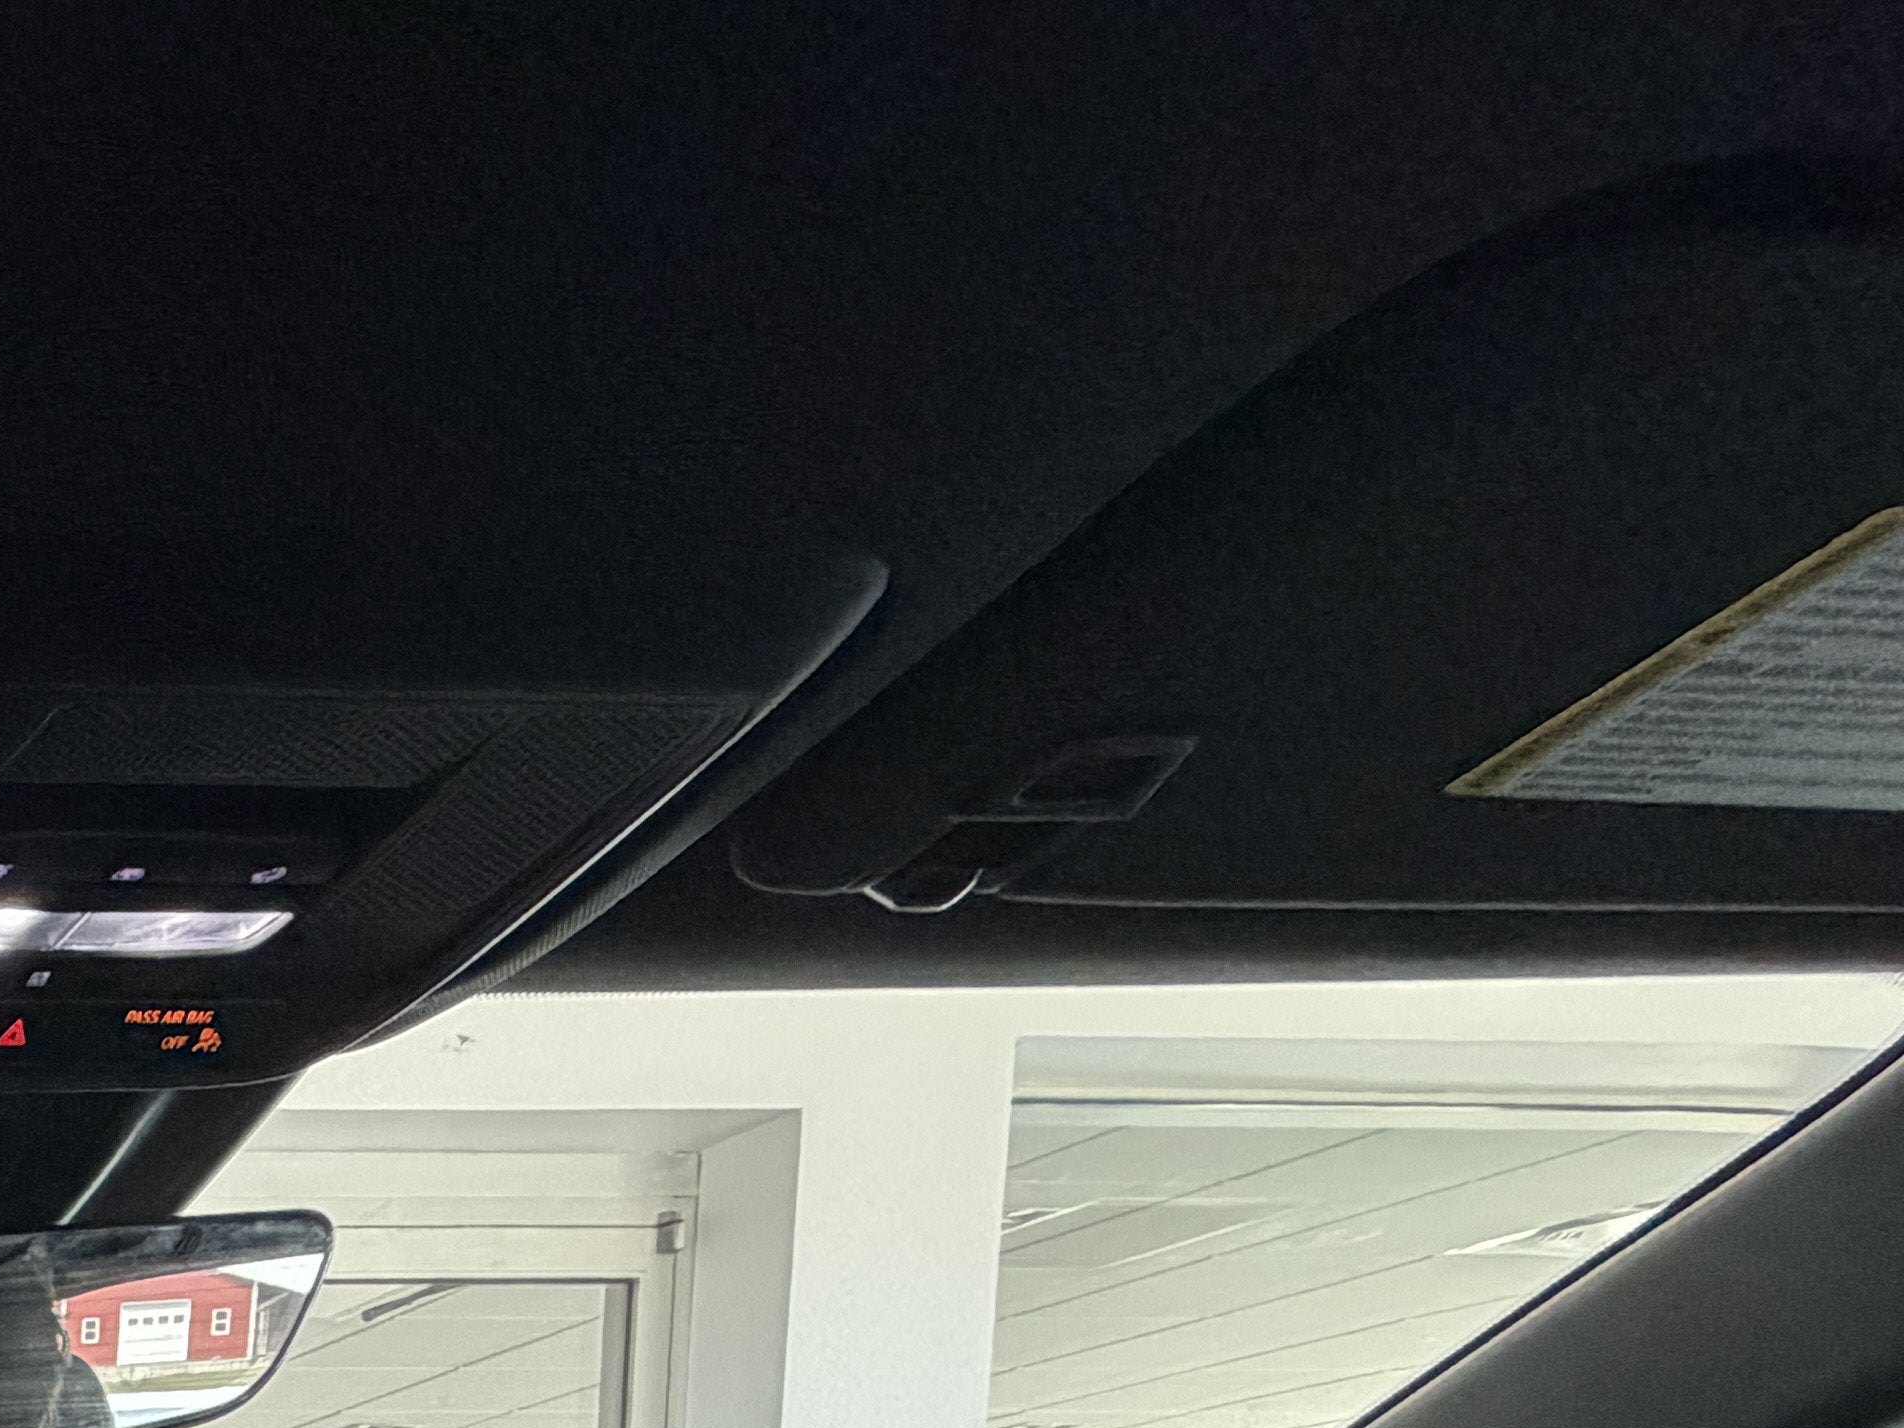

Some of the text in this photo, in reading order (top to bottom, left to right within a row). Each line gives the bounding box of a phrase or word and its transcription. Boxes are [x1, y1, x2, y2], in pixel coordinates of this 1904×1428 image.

[125, 1010, 159, 1024] PASS
[161, 1010, 183, 1024] AIR
[160, 1035, 189, 1050] OFF
